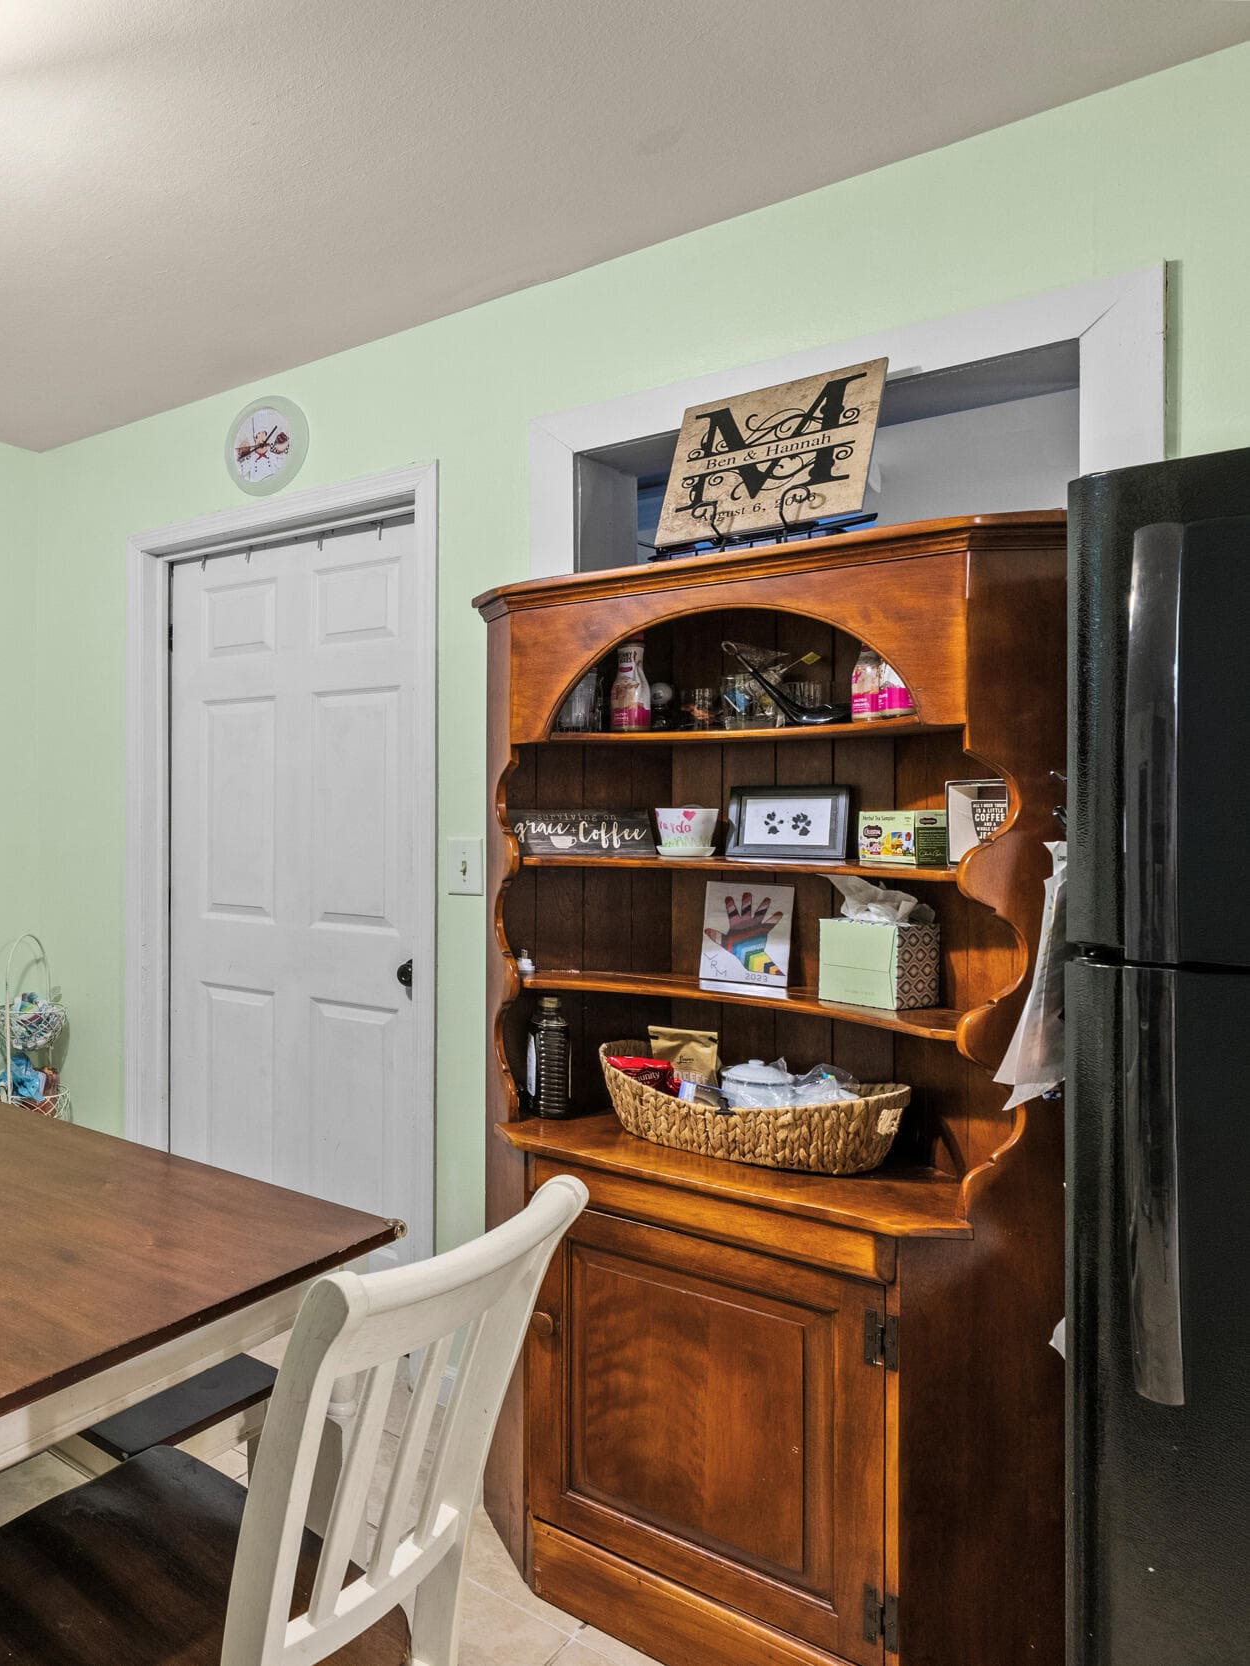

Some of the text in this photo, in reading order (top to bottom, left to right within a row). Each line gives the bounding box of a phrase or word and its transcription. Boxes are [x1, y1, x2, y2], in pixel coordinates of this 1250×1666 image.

[706, 434, 831, 470] Ben & Hannah
[752, 502, 766, 513] 6,
[537, 813, 597, 821] surviving
[974, 813, 1006, 822] COFFEE
[514, 819, 570, 843] grace
[579, 821, 646, 849] Coffee
[745, 973, 768, 983] 2023
